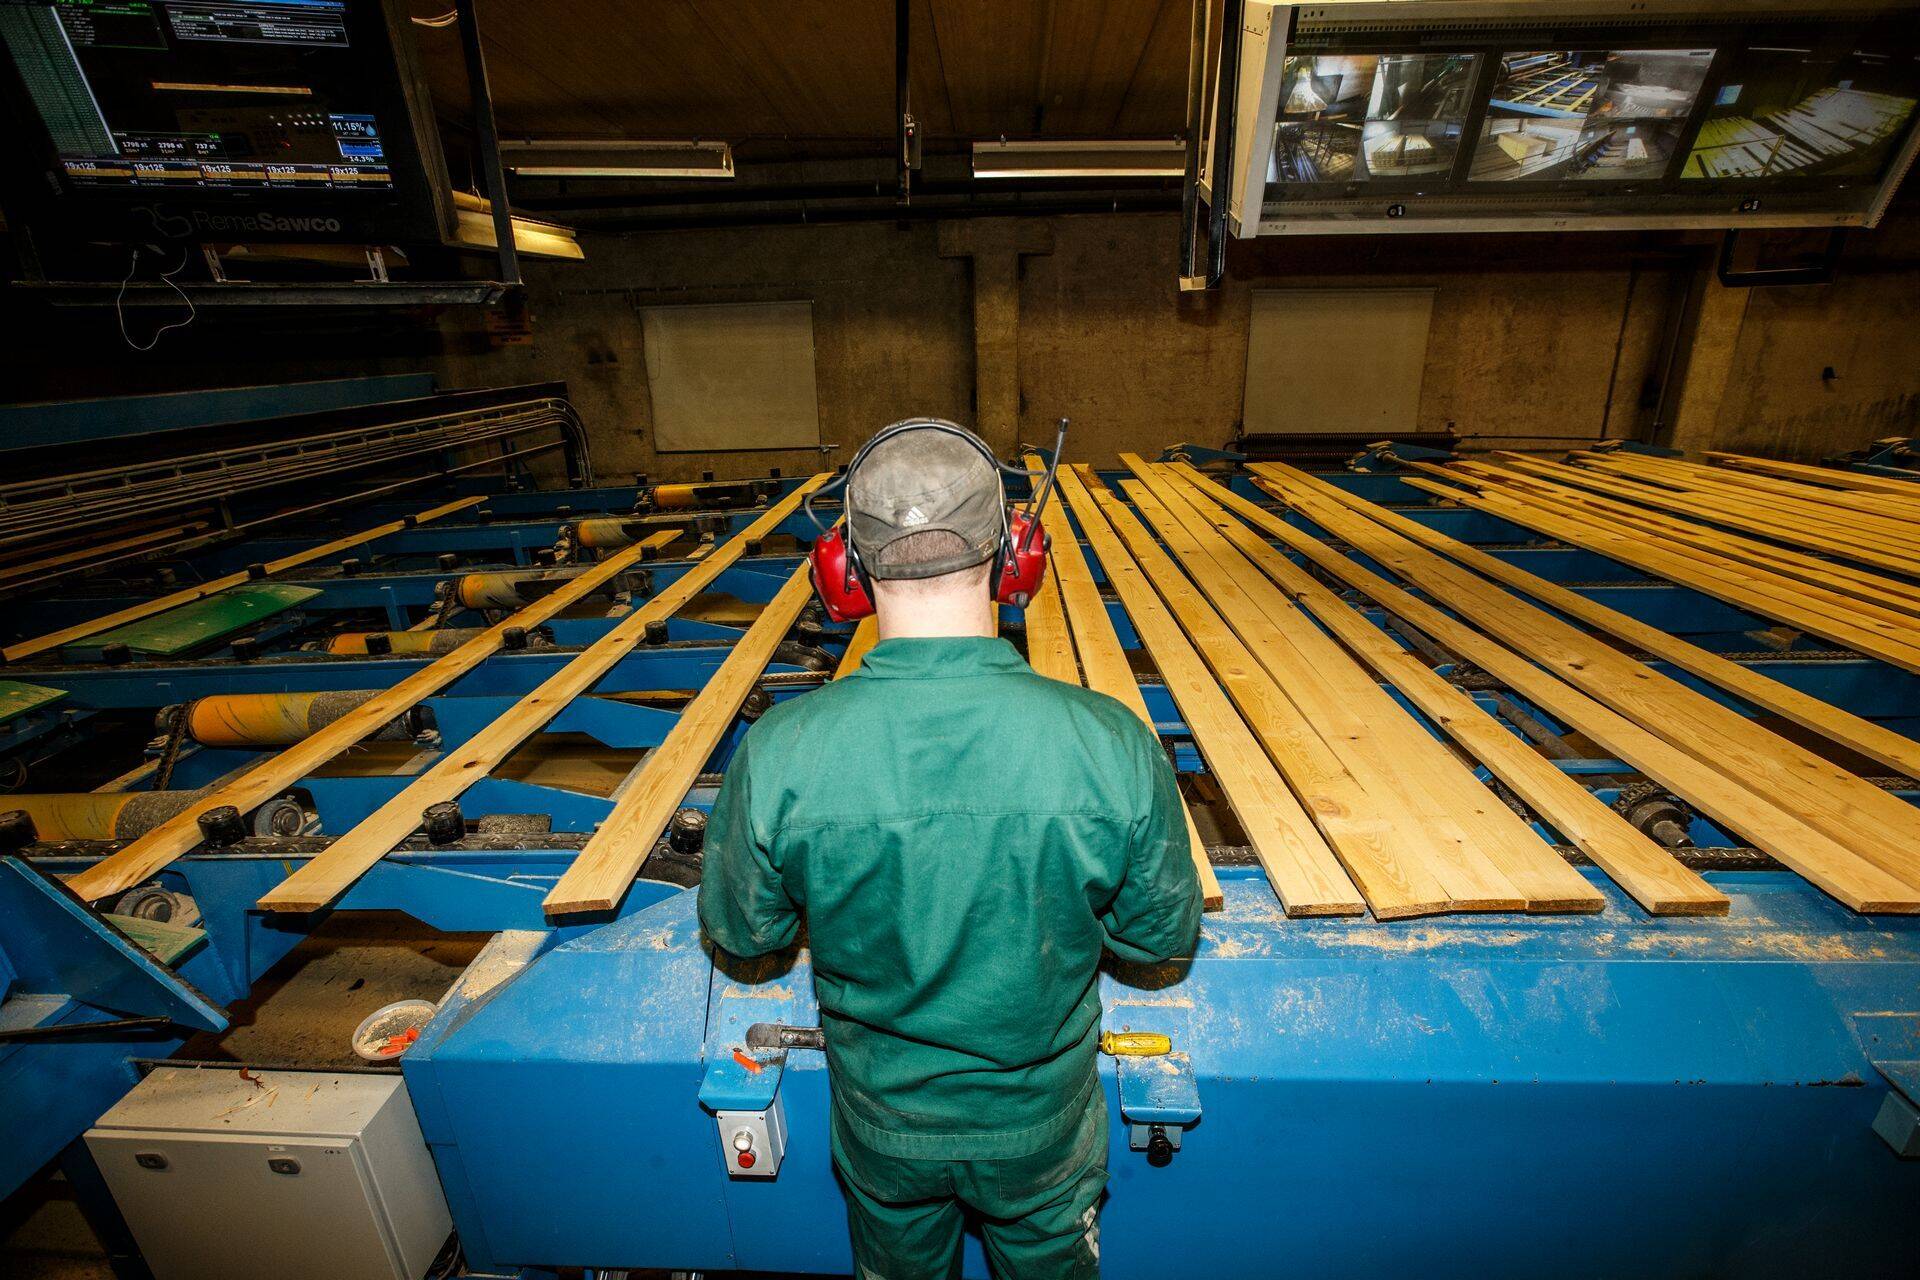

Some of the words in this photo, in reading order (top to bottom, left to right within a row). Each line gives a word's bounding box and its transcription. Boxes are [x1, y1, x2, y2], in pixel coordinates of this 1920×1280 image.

[332, 121, 365, 131] 11.15%
[64, 161, 97, 170] 19x125
[134, 163, 165, 171] 19x125
[202, 164, 231, 173] 19x125
[267, 166, 296, 174] 19x125
[330, 167, 359, 175] 19x125
[192, 210, 340, 233] RemaSawco
